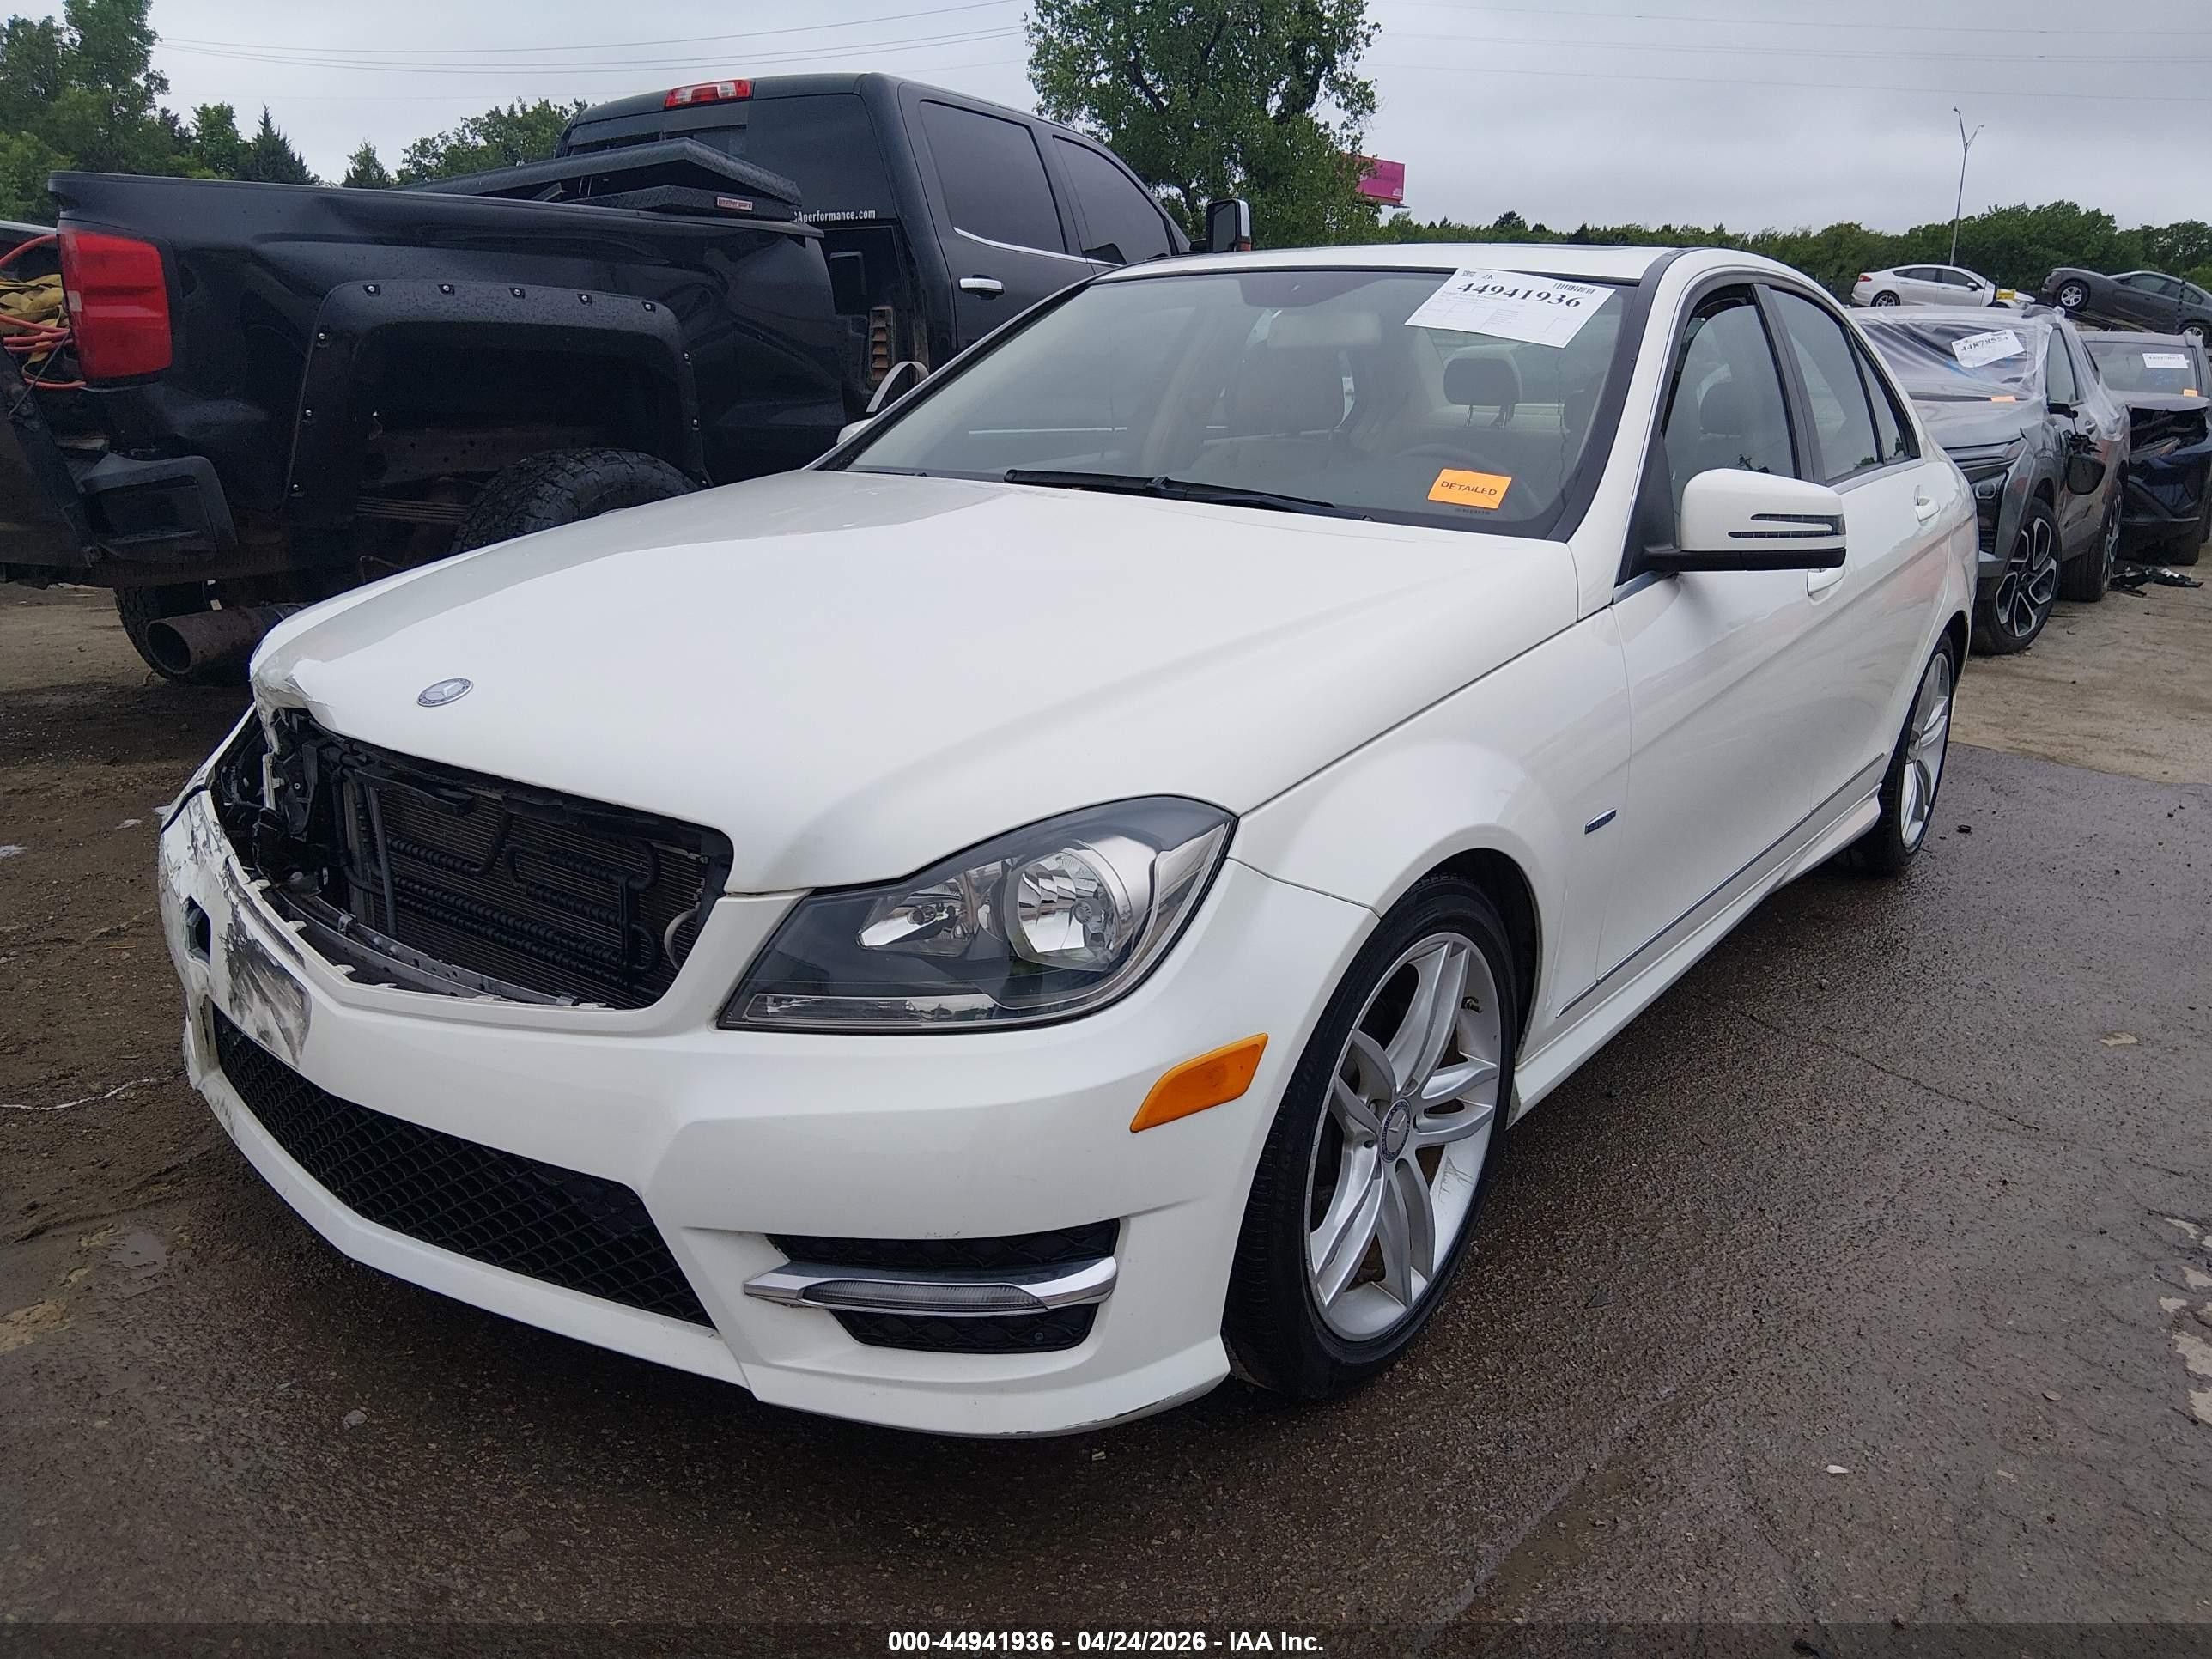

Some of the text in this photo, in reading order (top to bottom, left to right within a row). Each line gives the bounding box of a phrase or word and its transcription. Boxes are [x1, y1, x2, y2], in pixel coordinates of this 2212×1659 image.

[795, 210, 876, 222] Aperformance.com
[1457, 282, 1586, 308] 44941936
[1440, 480, 1498, 495] DETAILED
